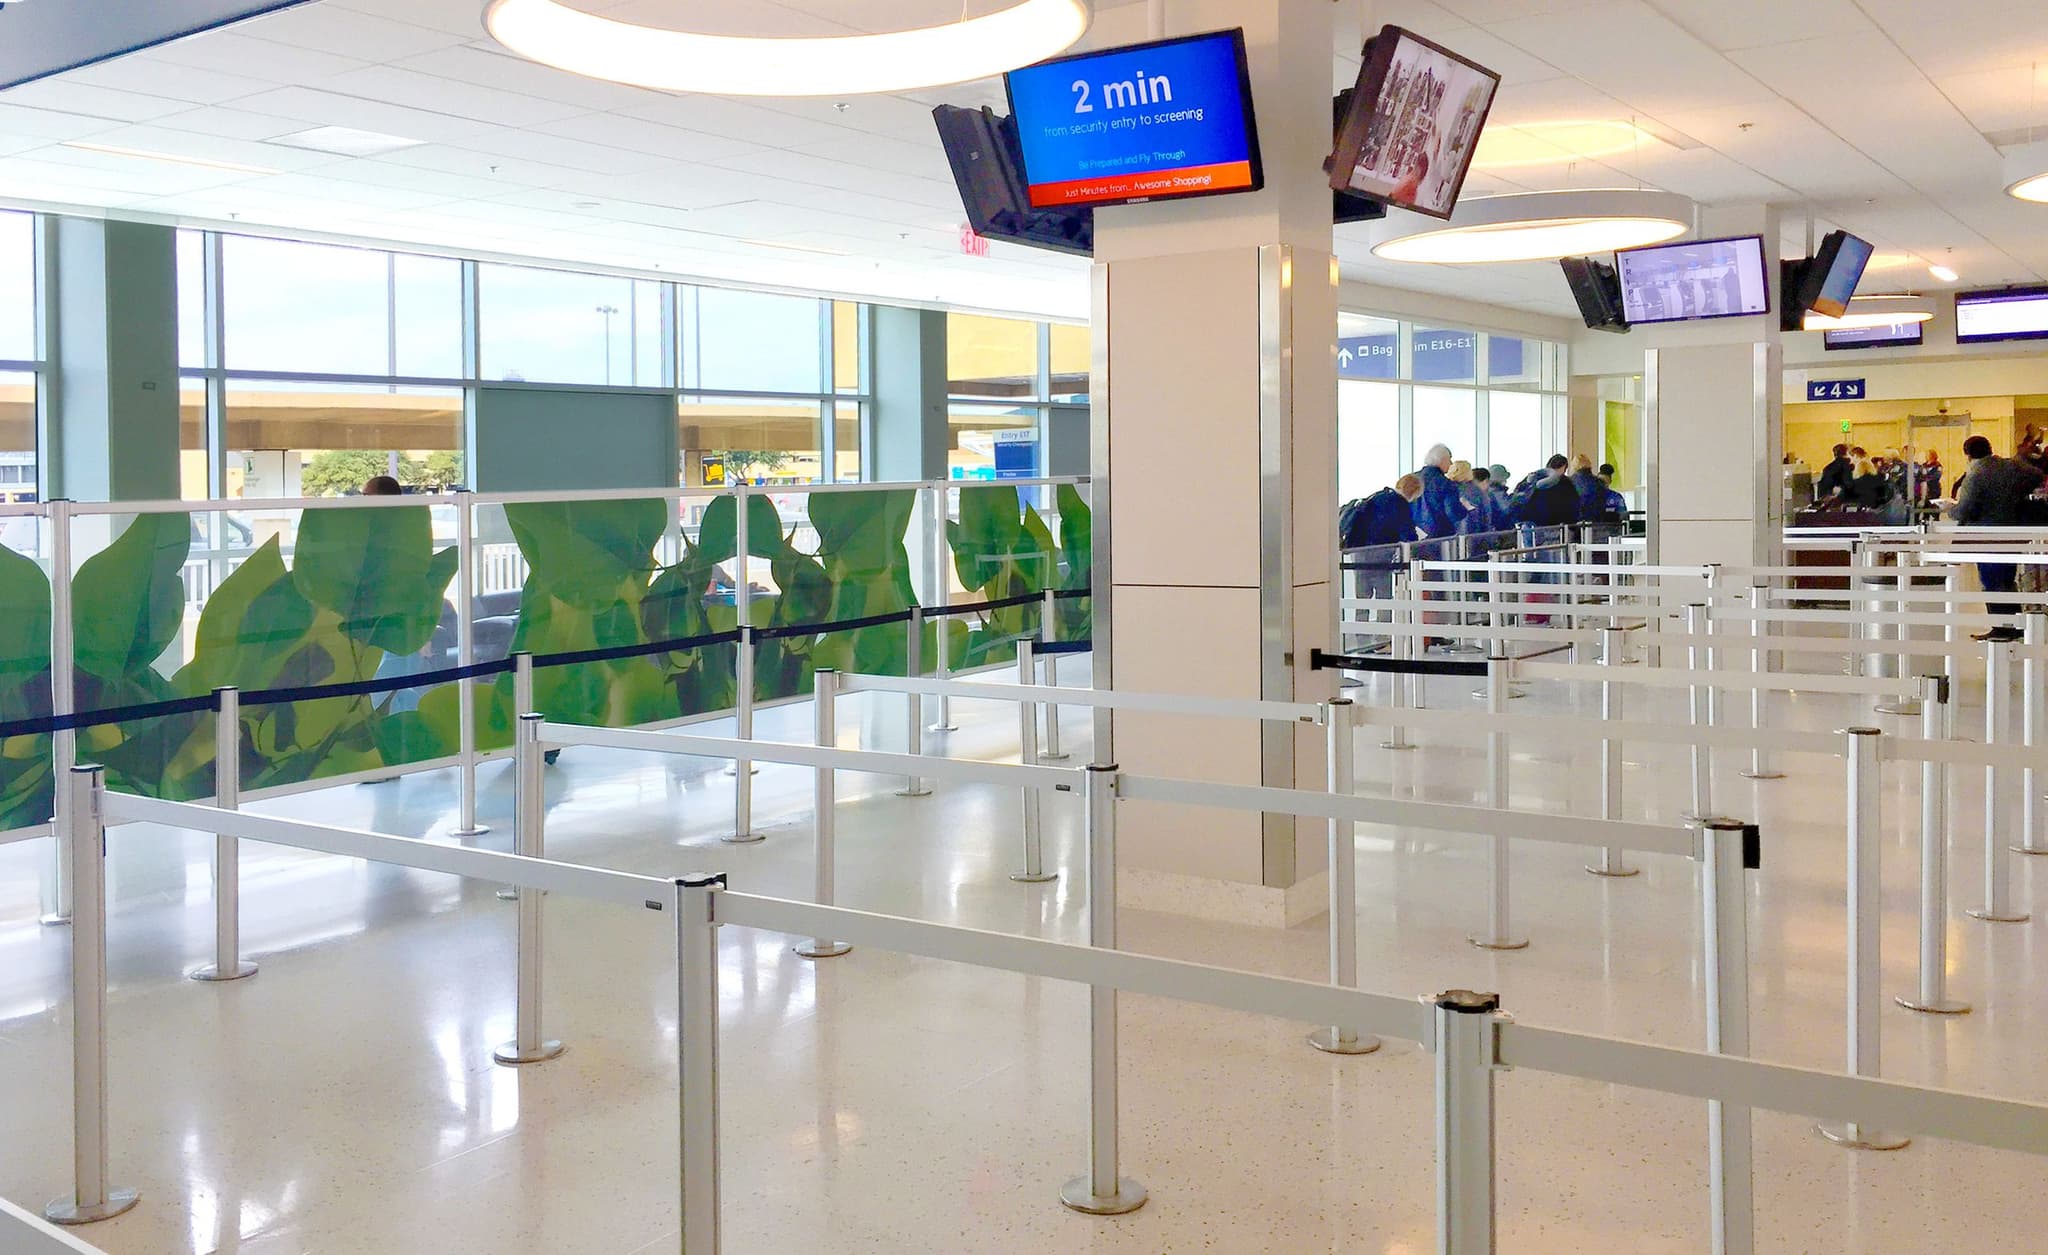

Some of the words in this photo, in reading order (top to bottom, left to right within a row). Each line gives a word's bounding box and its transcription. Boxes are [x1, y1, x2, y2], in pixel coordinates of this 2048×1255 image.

[1071, 79, 1093, 114] 2
[1103, 70, 1172, 109] min
[1044, 125, 1069, 137] from
[1071, 120, 1108, 137] security
[1111, 116, 1137, 130] entry
[1140, 114, 1152, 125] to
[1154, 107, 1204, 124] screening
[1089, 156, 1123, 170] Prepared
[1124, 154, 1138, 165] and
[1139, 153, 1151, 165] Fly
[1152, 149, 1186, 161] Through
[1065, 187, 1079, 198] Just
[1080, 185, 1108, 196] Minutes
[1134, 178, 1171, 190] Awesome
[1372, 344, 1393, 357] Bag
[1431, 337, 1476, 351] E16-E1
[1830, 382, 1842, 398] 4
